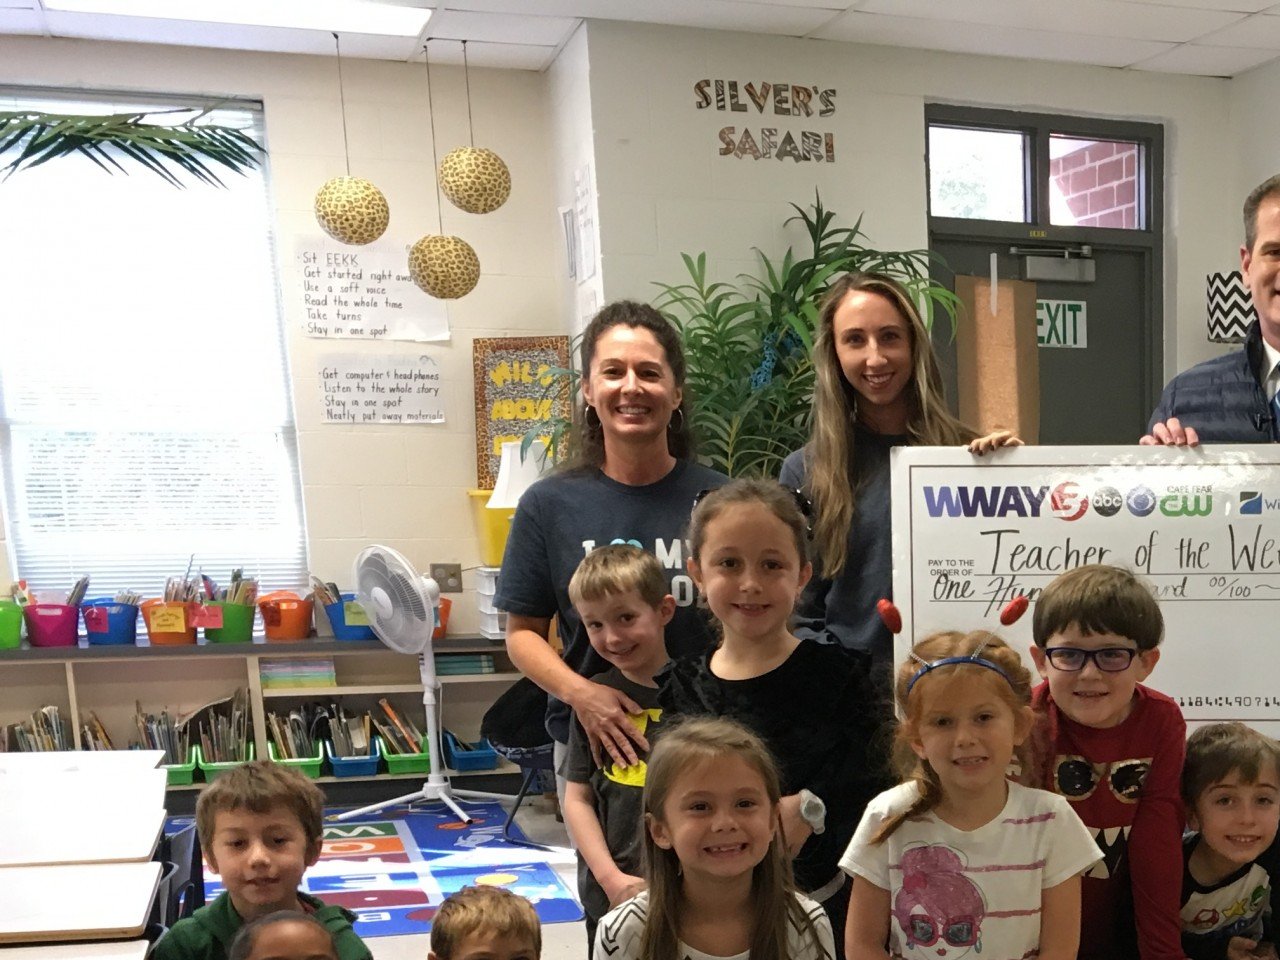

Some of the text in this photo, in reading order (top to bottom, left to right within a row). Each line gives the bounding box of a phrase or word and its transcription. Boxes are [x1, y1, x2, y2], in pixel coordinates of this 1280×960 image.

[694, 79, 837, 118] SILVER'S
[718, 126, 836, 164] SAFARI
[303, 252, 359, 267] Sit EEKK
[304, 266, 413, 283] Get started right awa
[304, 280, 386, 295] Use a soft voice
[305, 294, 403, 309] Read the whole time
[306, 308, 362, 321] Take turns
[308, 322, 388, 338] Stay in one spot
[1036, 302, 1082, 345] EXIT
[322, 368, 338, 379] Get
[346, 369, 384, 382] computer
[324, 381, 440, 397] Listen to the whole story
[325, 395, 346, 410] Stay
[352, 399, 359, 407] in
[383, 396, 403, 409] spot
[326, 409, 444, 423] Neatly put away materials
[923, 486, 1050, 517] WWAY
[1093, 495, 1123, 507] abc
[655, 538, 694, 569] M
[980, 529, 1112, 575] Teacher
[1135, 530, 1159, 574] of
[1174, 537, 1210, 569] the
[933, 573, 975, 600] One
